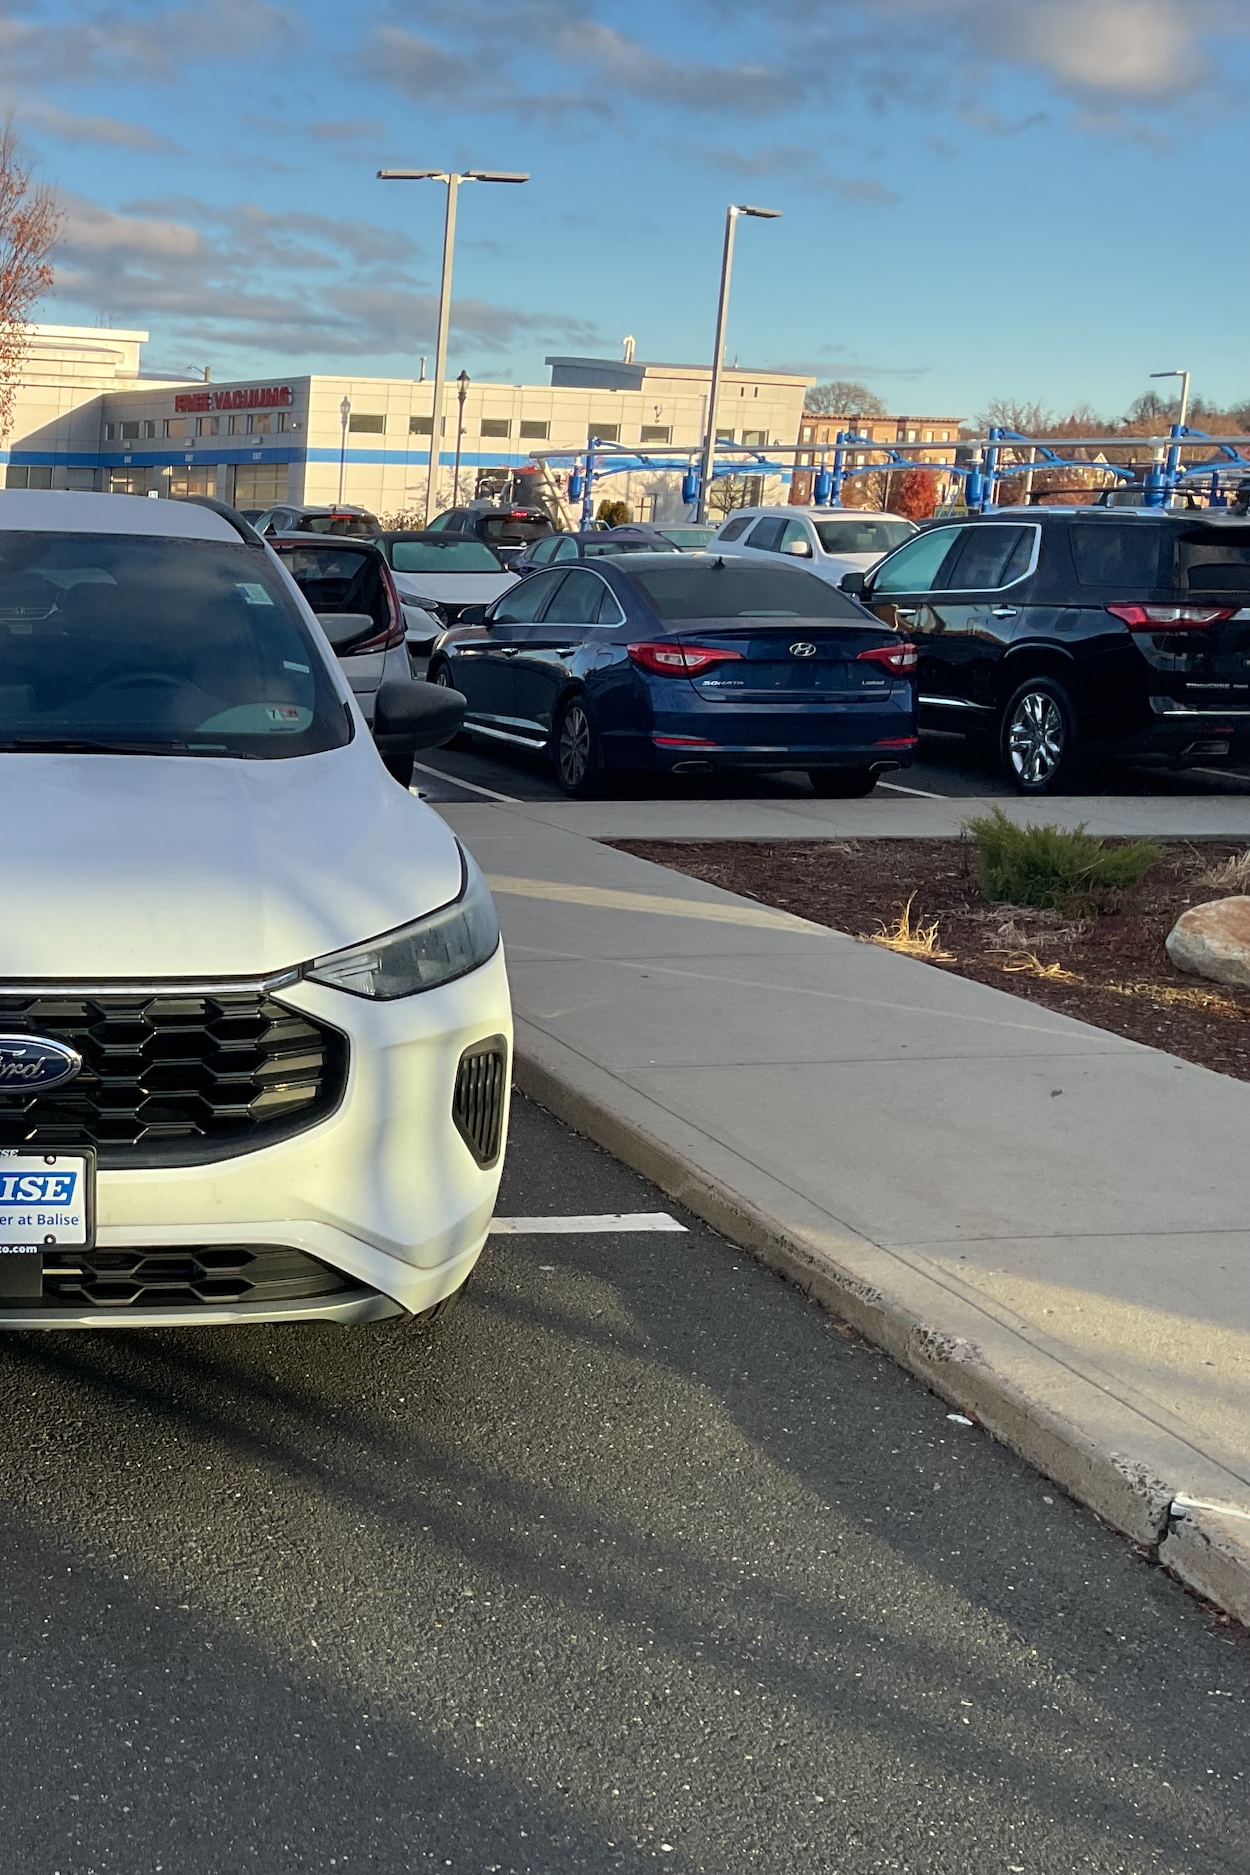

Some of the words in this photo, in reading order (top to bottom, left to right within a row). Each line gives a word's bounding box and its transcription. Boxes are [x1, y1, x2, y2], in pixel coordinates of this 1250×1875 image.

[175, 393, 212, 412] FREE
[214, 387, 293, 410] VACUUMS
[18, 1215, 33, 1225] at
[37, 1214, 80, 1225] Balise
